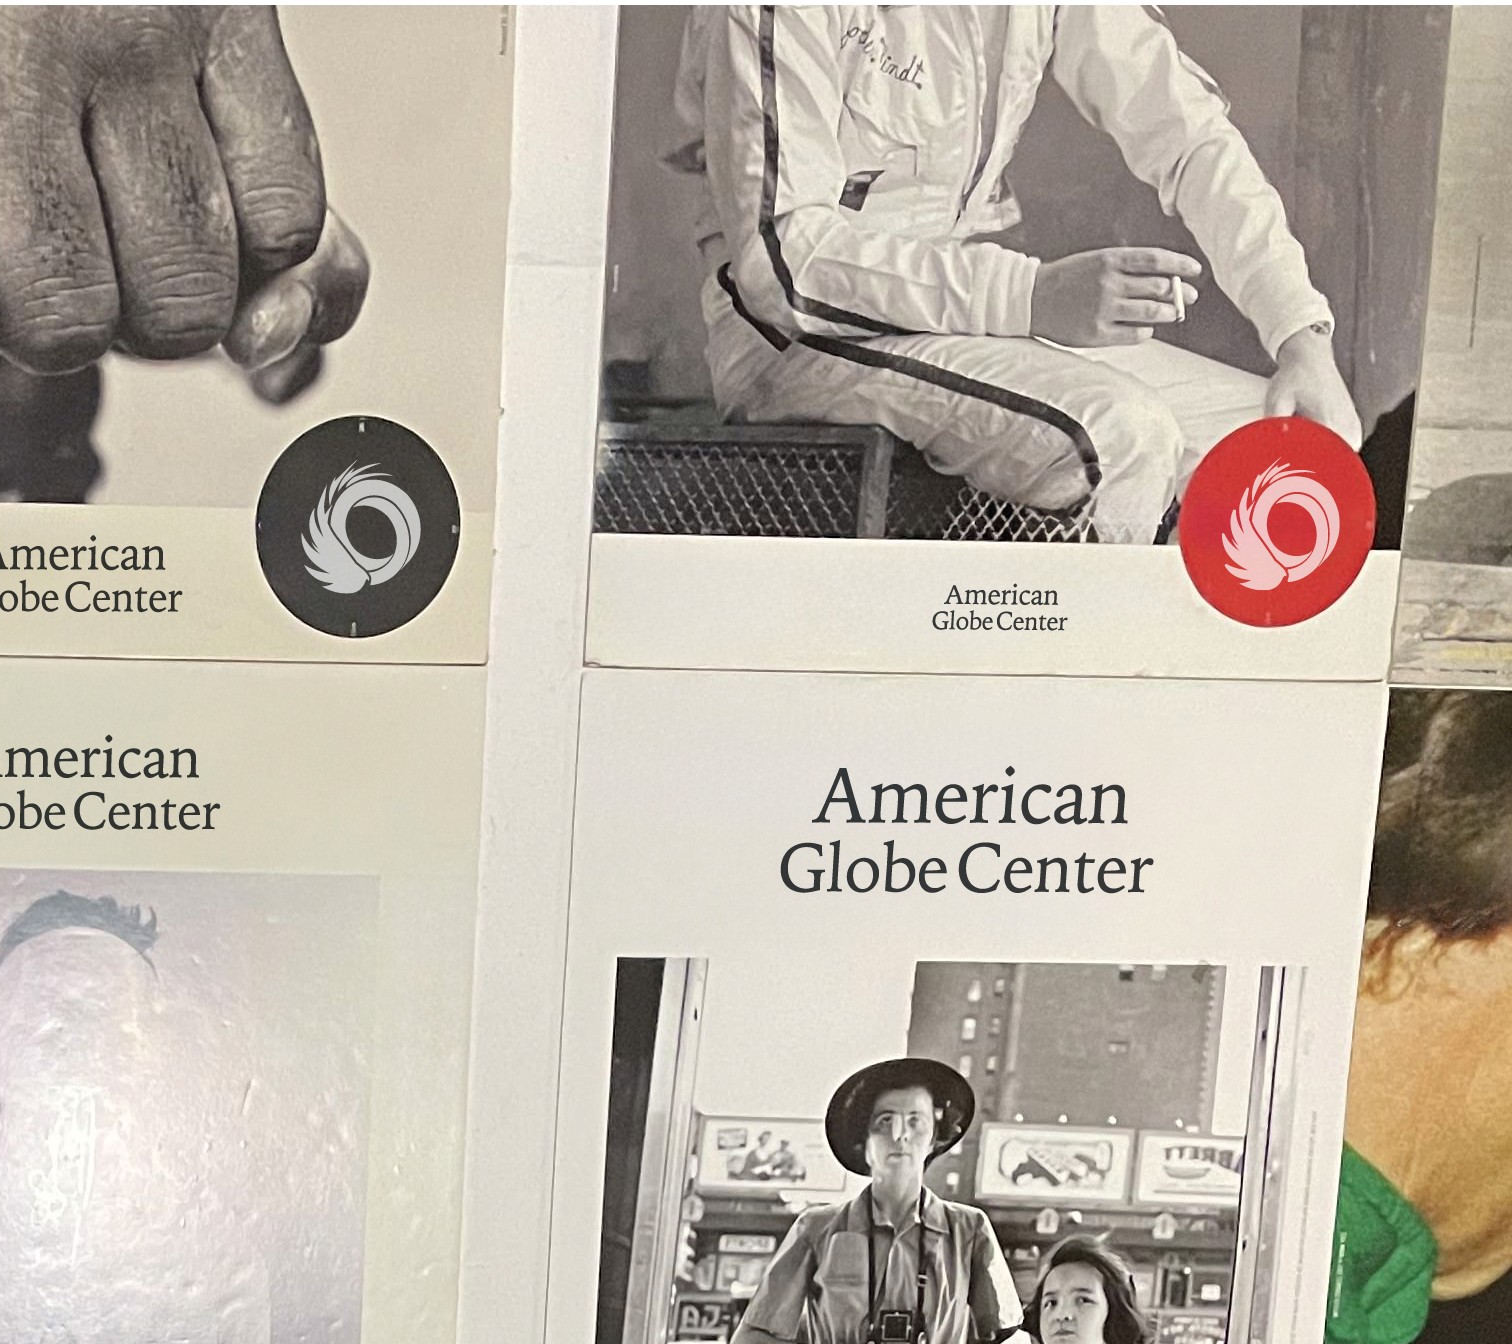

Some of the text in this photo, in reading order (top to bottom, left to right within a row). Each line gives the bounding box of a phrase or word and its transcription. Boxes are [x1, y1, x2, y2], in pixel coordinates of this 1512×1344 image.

[65, 580, 183, 613] Center
[943, 583, 1059, 606] American
[932, 610, 1068, 631] Globe Center
[73, 791, 221, 831] Center
[811, 765, 1128, 825] American
[780, 839, 1154, 894] Globe Center
